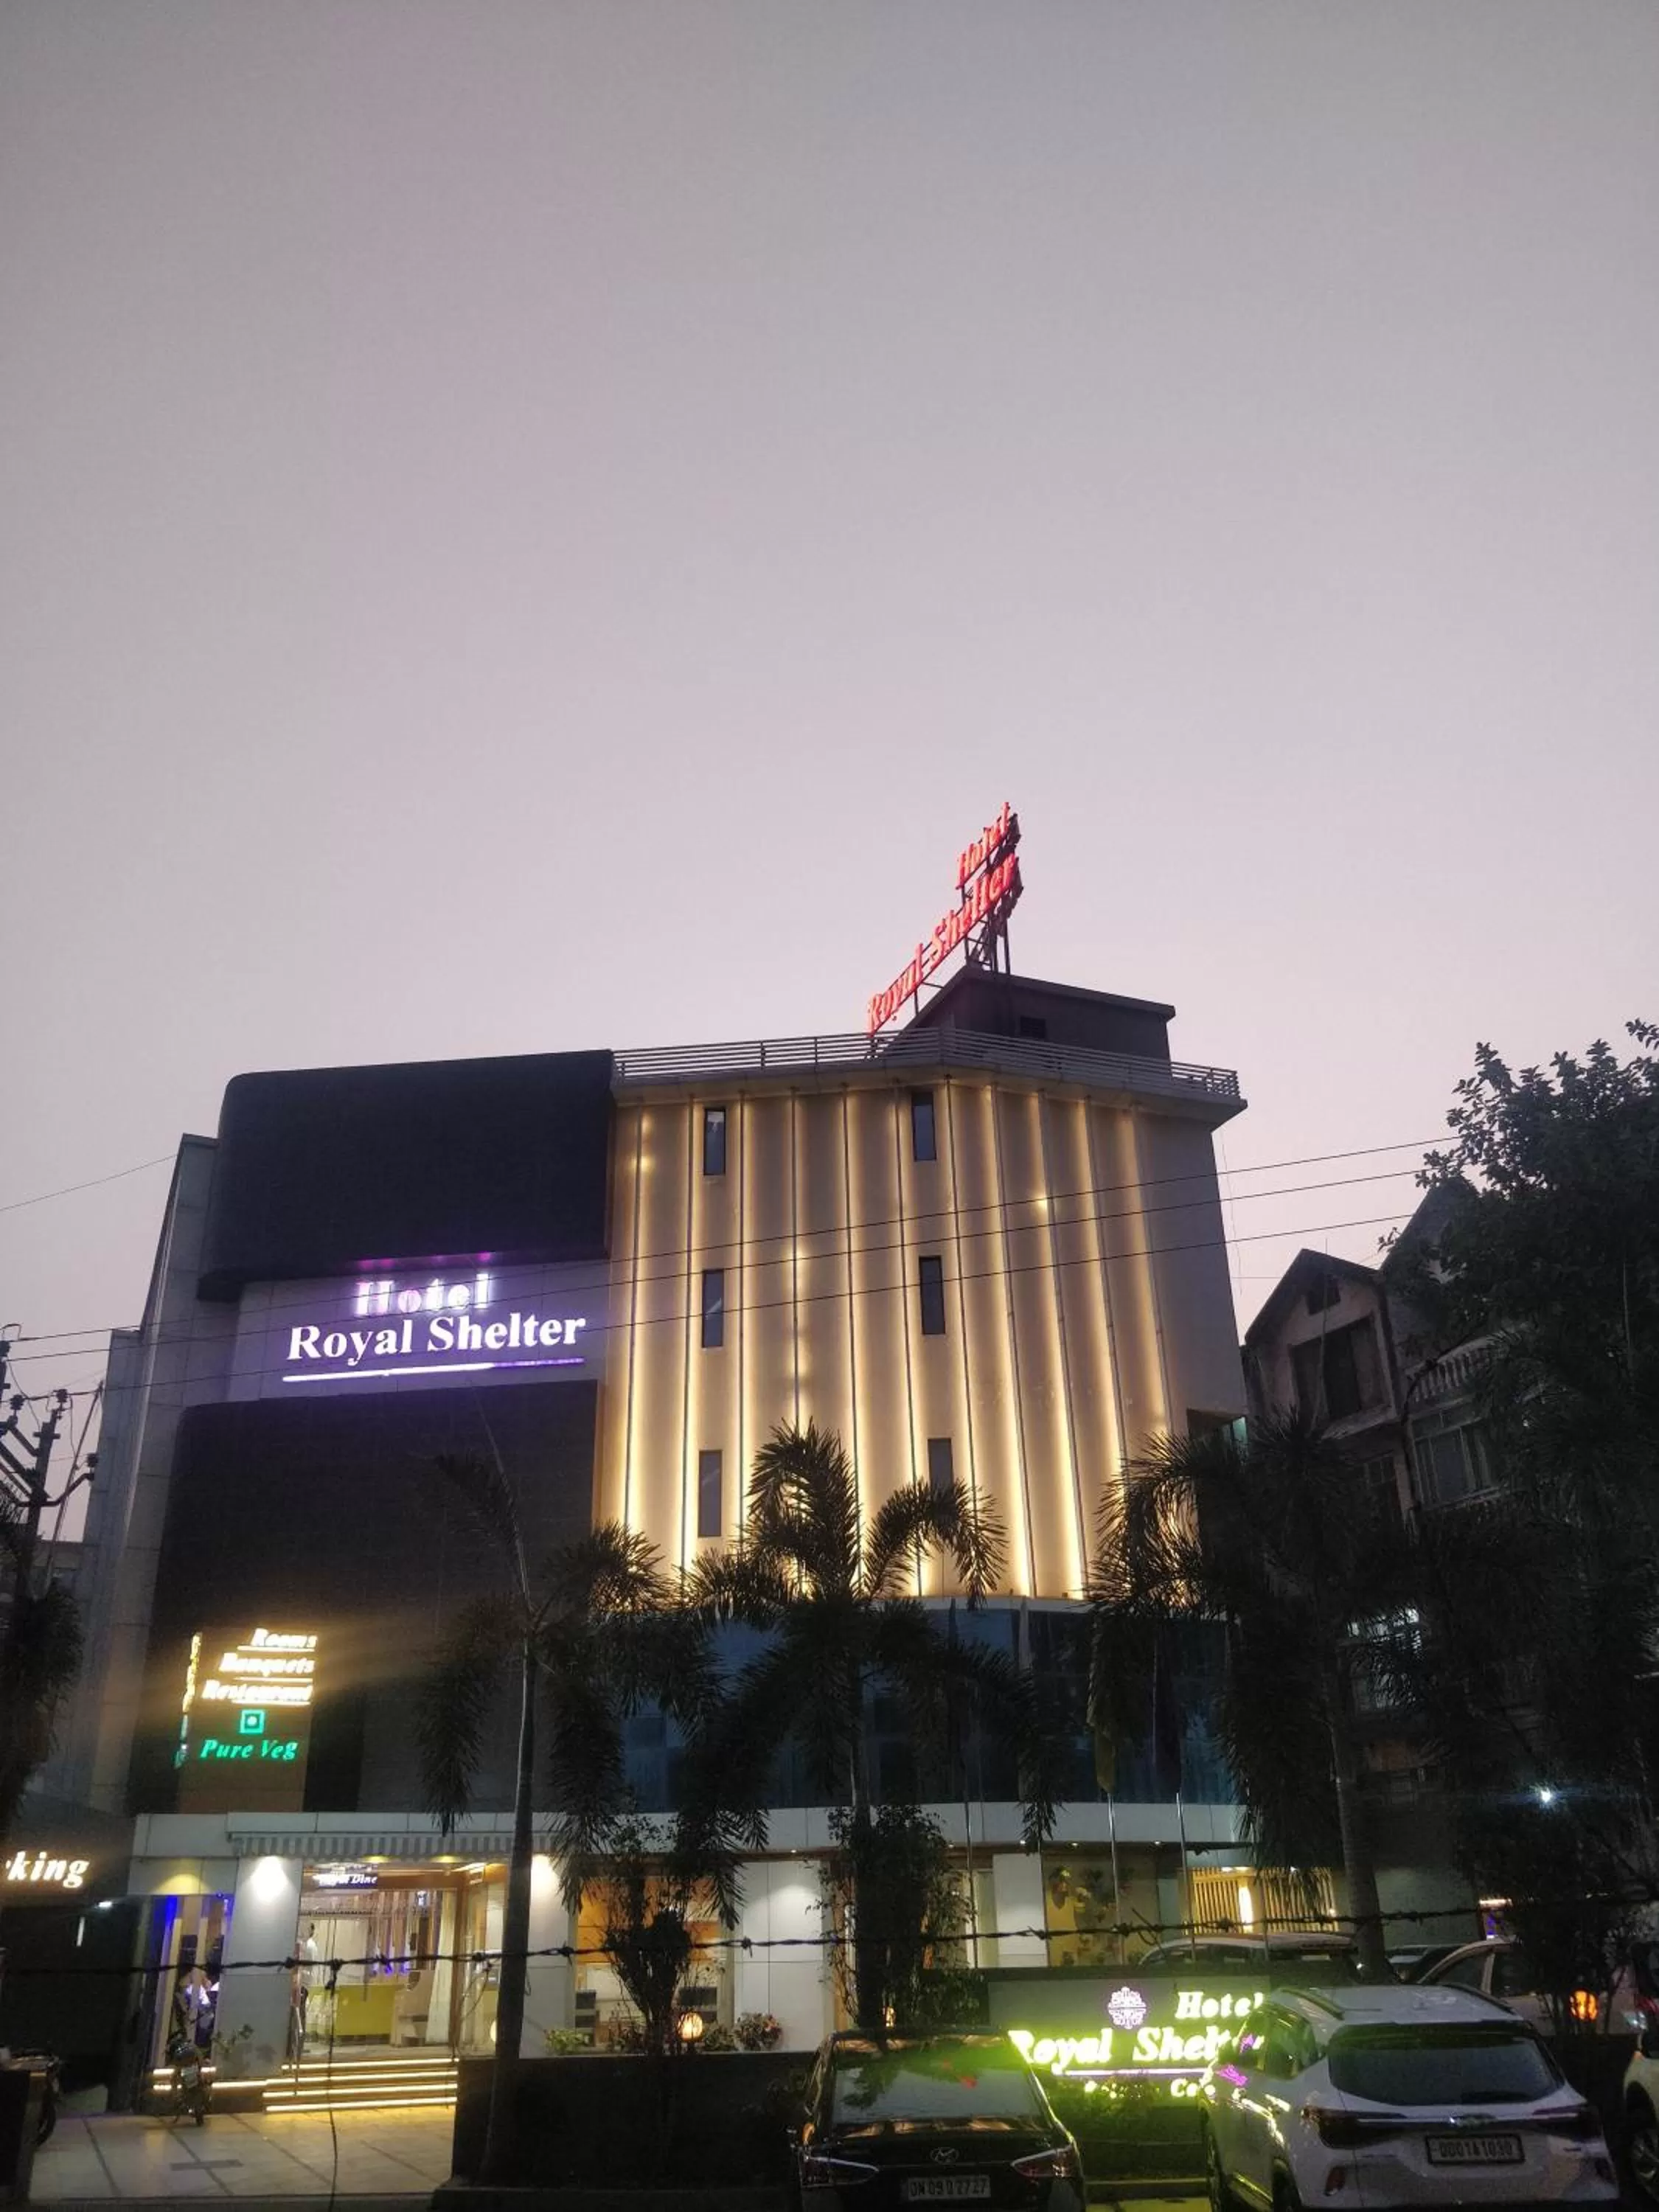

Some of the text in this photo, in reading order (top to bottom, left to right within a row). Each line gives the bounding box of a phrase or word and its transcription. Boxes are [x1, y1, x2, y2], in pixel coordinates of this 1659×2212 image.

[355, 1272, 491, 1316] Hotel
[286, 1312, 587, 1366] Royal Shelter
[199, 1739, 299, 1761] Pure Veg
[5, 1850, 90, 1888] king
[1174, 1990, 1265, 2020] Hotel
[1007, 2028, 1113, 2076] Royal
